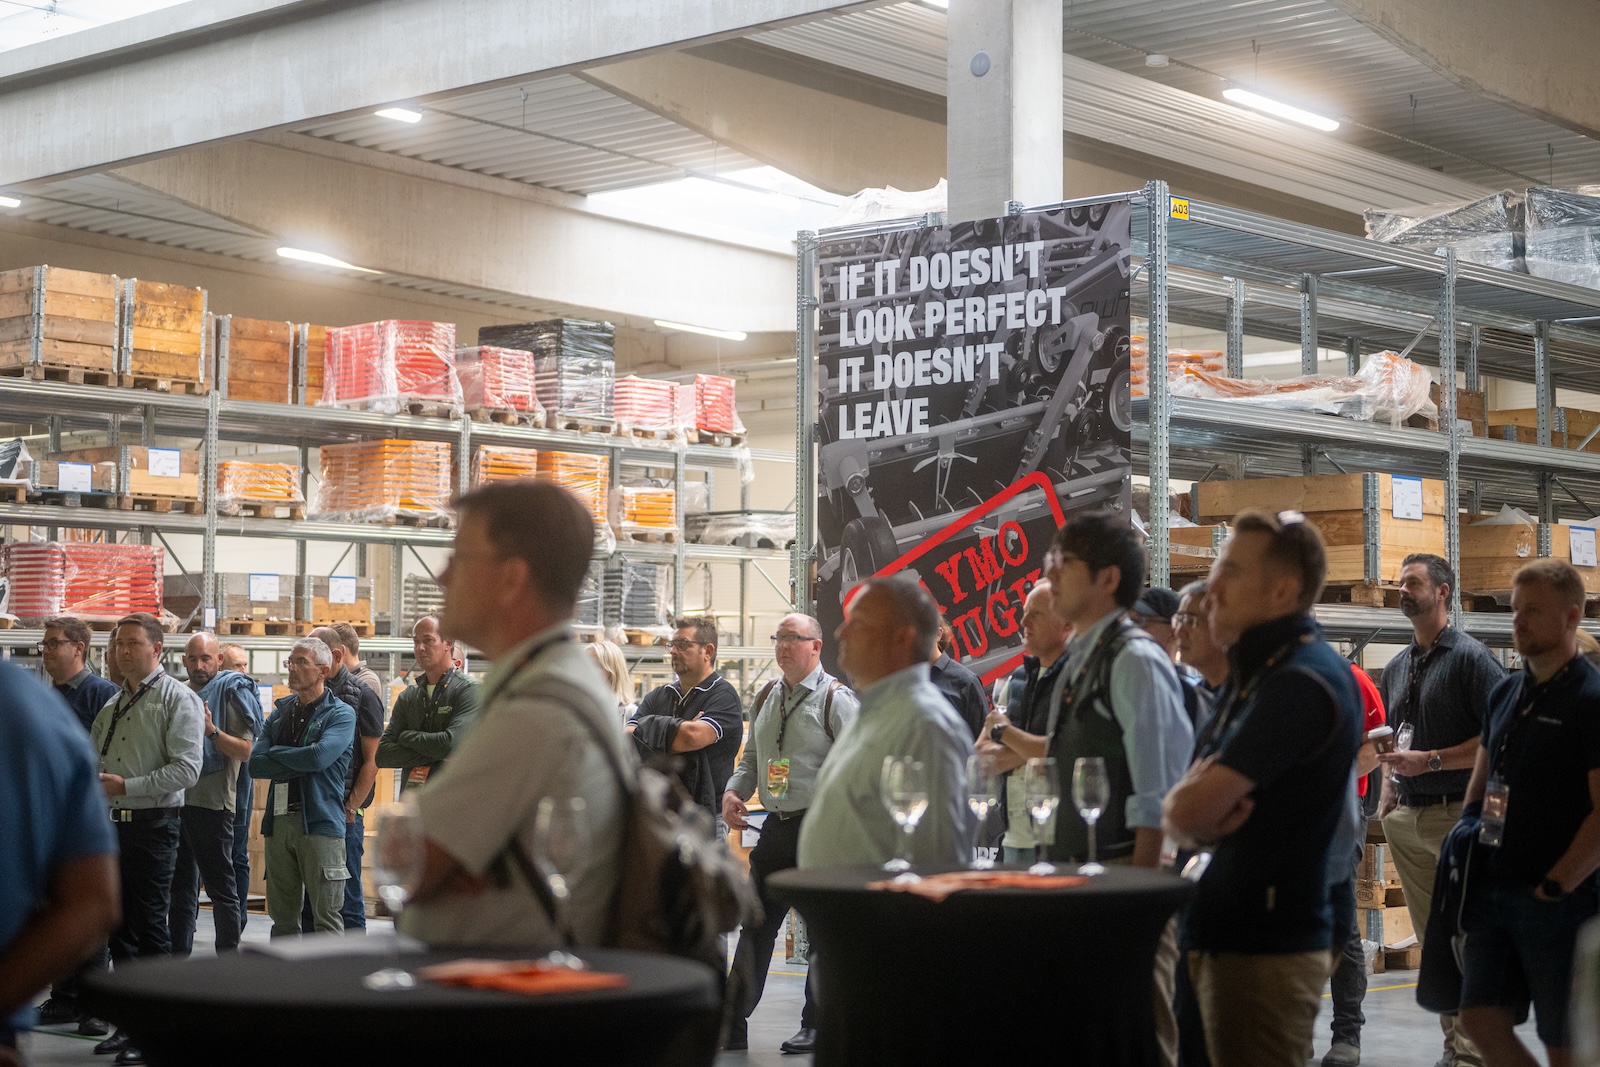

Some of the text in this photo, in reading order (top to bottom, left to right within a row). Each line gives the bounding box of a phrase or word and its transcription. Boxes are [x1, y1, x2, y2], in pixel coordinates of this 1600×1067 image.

[1172, 203, 1188, 215] A03
[839, 240, 1045, 301] IF IT DOESN’T
[839, 286, 1067, 347] LOOK PERFECT
[838, 342, 1005, 393] IT DOESN’T
[838, 397, 929, 439] LEAVE
